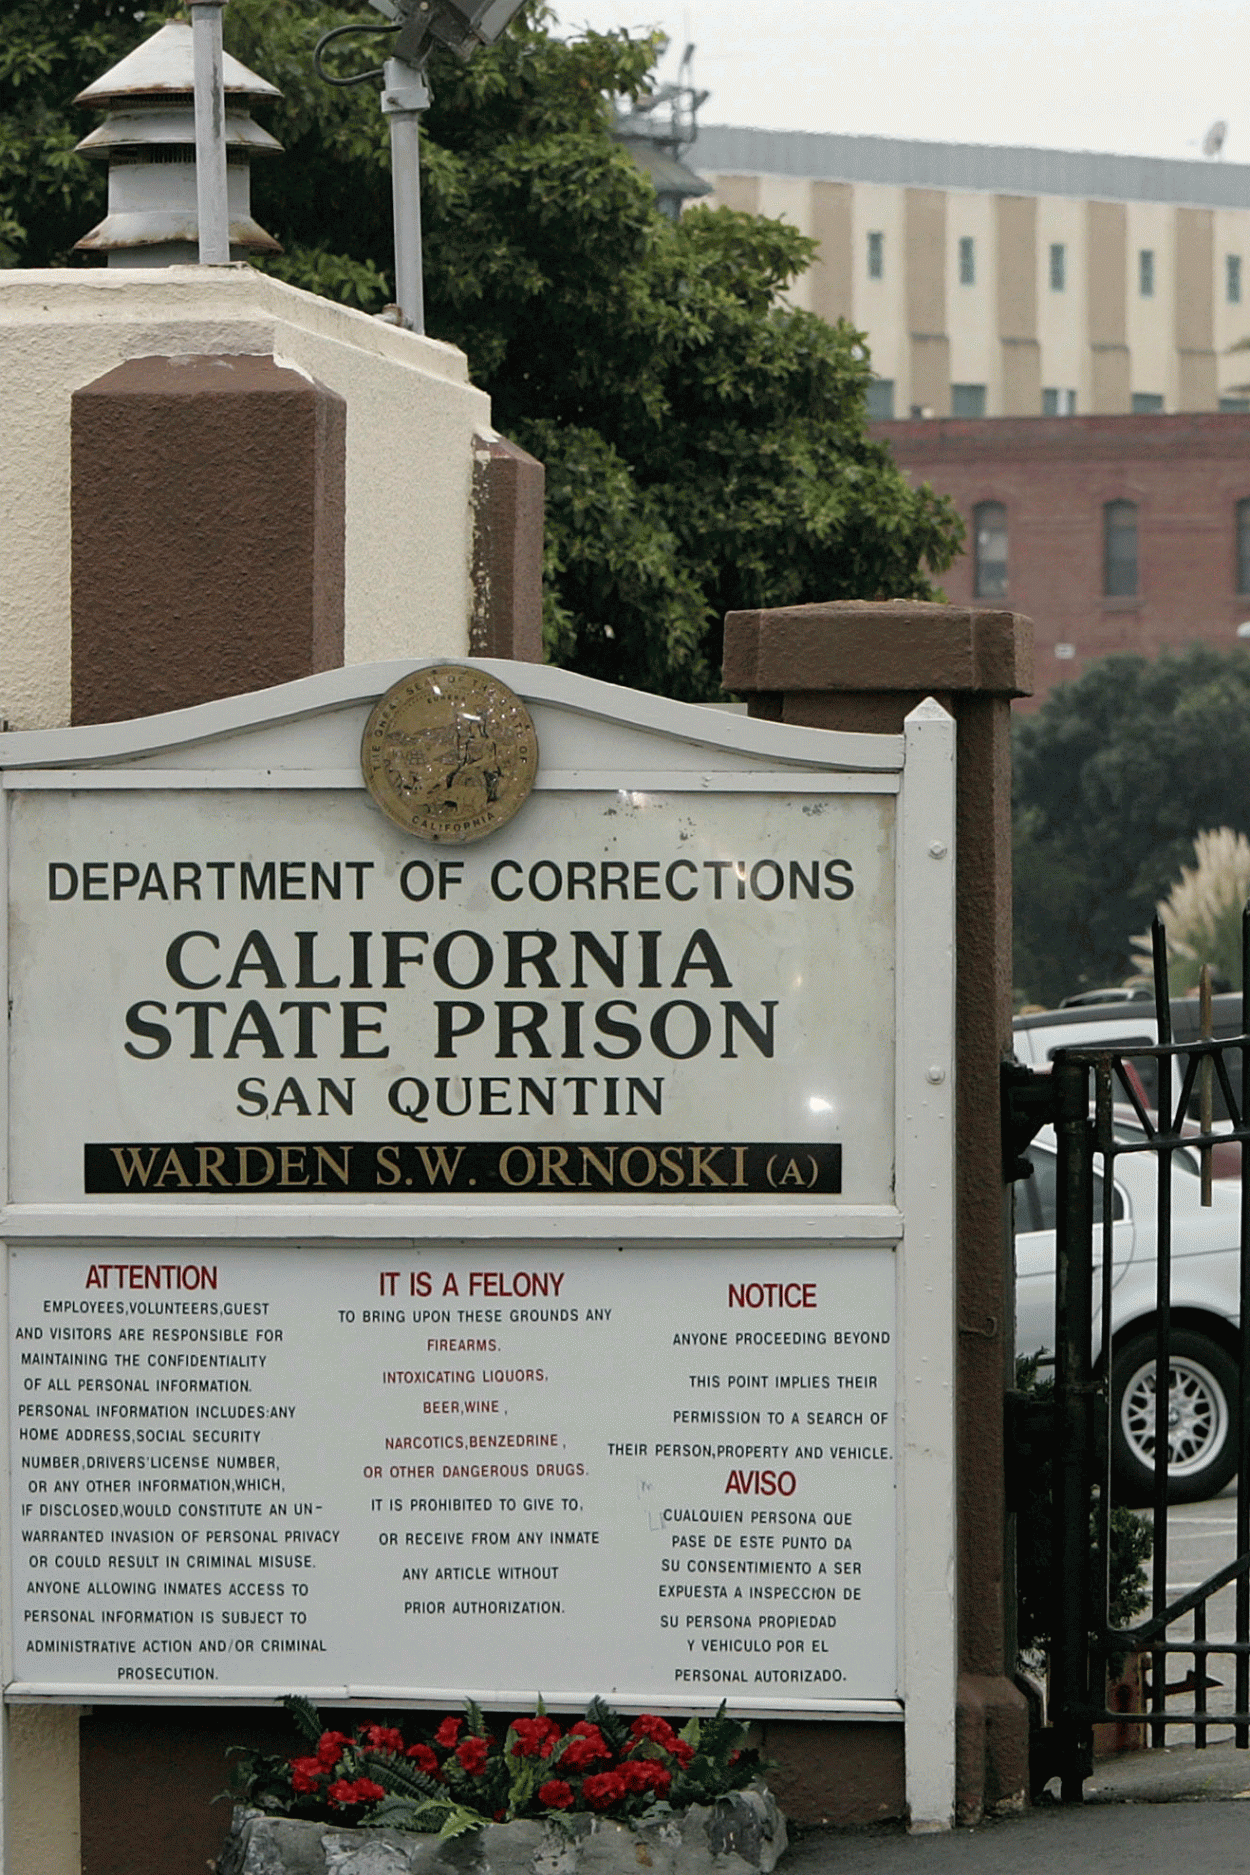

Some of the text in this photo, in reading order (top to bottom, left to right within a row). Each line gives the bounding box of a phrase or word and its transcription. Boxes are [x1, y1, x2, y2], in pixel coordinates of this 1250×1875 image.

[411, 812, 496, 832] CALIFORNIA
[48, 858, 854, 902] DEPARTMENT OF CORRECTIONS
[165, 928, 733, 990] CALIFORNIA
[123, 999, 779, 1060] STATE PRISON
[236, 1076, 665, 1123] SAN QUENTIN
[108, 1145, 818, 1188] WARDEN S.W. ORNOSKI (A)
[85, 1264, 217, 1290] ATTENTION
[379, 1271, 564, 1297] IT IS A FELONY
[728, 1282, 817, 1308] NOTICE
[337, 1308, 611, 1323] TO BRING UPON THESE GROUNDS ANY
[15, 1326, 282, 1342] AND VISITORS ARE RESPONSIBLE FOR
[672, 1331, 890, 1345] ANYONE PROCEEDING BEYOND
[427, 1338, 499, 1351] FIREARMS.
[21, 1352, 266, 1367] MAINTAINING THE CONFIDENTIALITY
[382, 1370, 475, 1383] INTOXICATING
[688, 1374, 877, 1388] THIS POINT IMPLIES THEIR
[23, 1377, 251, 1392] OF ALL PERSONAL INFORMATION.
[18, 1403, 89, 1417] PERSONAL
[96, 1404, 188, 1418] INFORMATION
[673, 1410, 888, 1425] PERMISSION TO A SEARCH OF
[19, 1427, 58, 1440] HOME
[192, 1429, 260, 1443] SECURITY
[607, 1442, 647, 1456] THEIR
[794, 1446, 823, 1459] AND
[829, 1446, 893, 1459] VEHICLE.
[216, 1456, 279, 1470] NUMBER,
[363, 1462, 587, 1478] OR OTHER DANGEROUS DRUGS.
[28, 1479, 47, 1493] OR
[53, 1480, 79, 1492] ANY
[85, 1479, 130, 1492] OTHER
[724, 1469, 796, 1496] AVISO
[21, 1503, 33, 1516] IF
[178, 1503, 261, 1517] CONSTITUTE
[269, 1503, 286, 1515] AN
[371, 1498, 581, 1511] IT IS PROHIBITED TO GIVE TO,
[662, 1508, 852, 1525] CUALQUIEN PERSONA QUE
[21, 1529, 339, 1543] WARRANTED INVASION OF PERSONAL PRIVACY
[378, 1531, 599, 1545] OR RECEIVE FROM ANY INMATE
[671, 1534, 852, 1549] PASE DE ESTE PUNTO DA
[28, 1554, 314, 1568] OR COULD RESULT IN CRIMINAL MISUSE.
[661, 1558, 861, 1574] SU CONSENTIMIENTO A SER
[402, 1566, 558, 1580] ANY ARTICLE WITHOUT
[26, 1581, 308, 1596] ANYONE ALLOWING INMATES ACCESS TO
[658, 1584, 861, 1600] EXPUESTA A INSPECCION DE
[404, 1600, 564, 1614] PRIOR AUTHORIZATION.
[24, 1609, 306, 1624] PERSONAL INFORMATION IS SUBJECT TO
[660, 1614, 836, 1628] SU PERSONA PROPIEDAD
[26, 1639, 326, 1653] ADMINISTRATIVE ACTION AND/OR CRIMINAL
[687, 1639, 828, 1652] Y VEHICULO POR EL
[117, 1666, 217, 1680] PROSECUTION.
[674, 1668, 846, 1682] PERSONAL AUTORIZADO.
